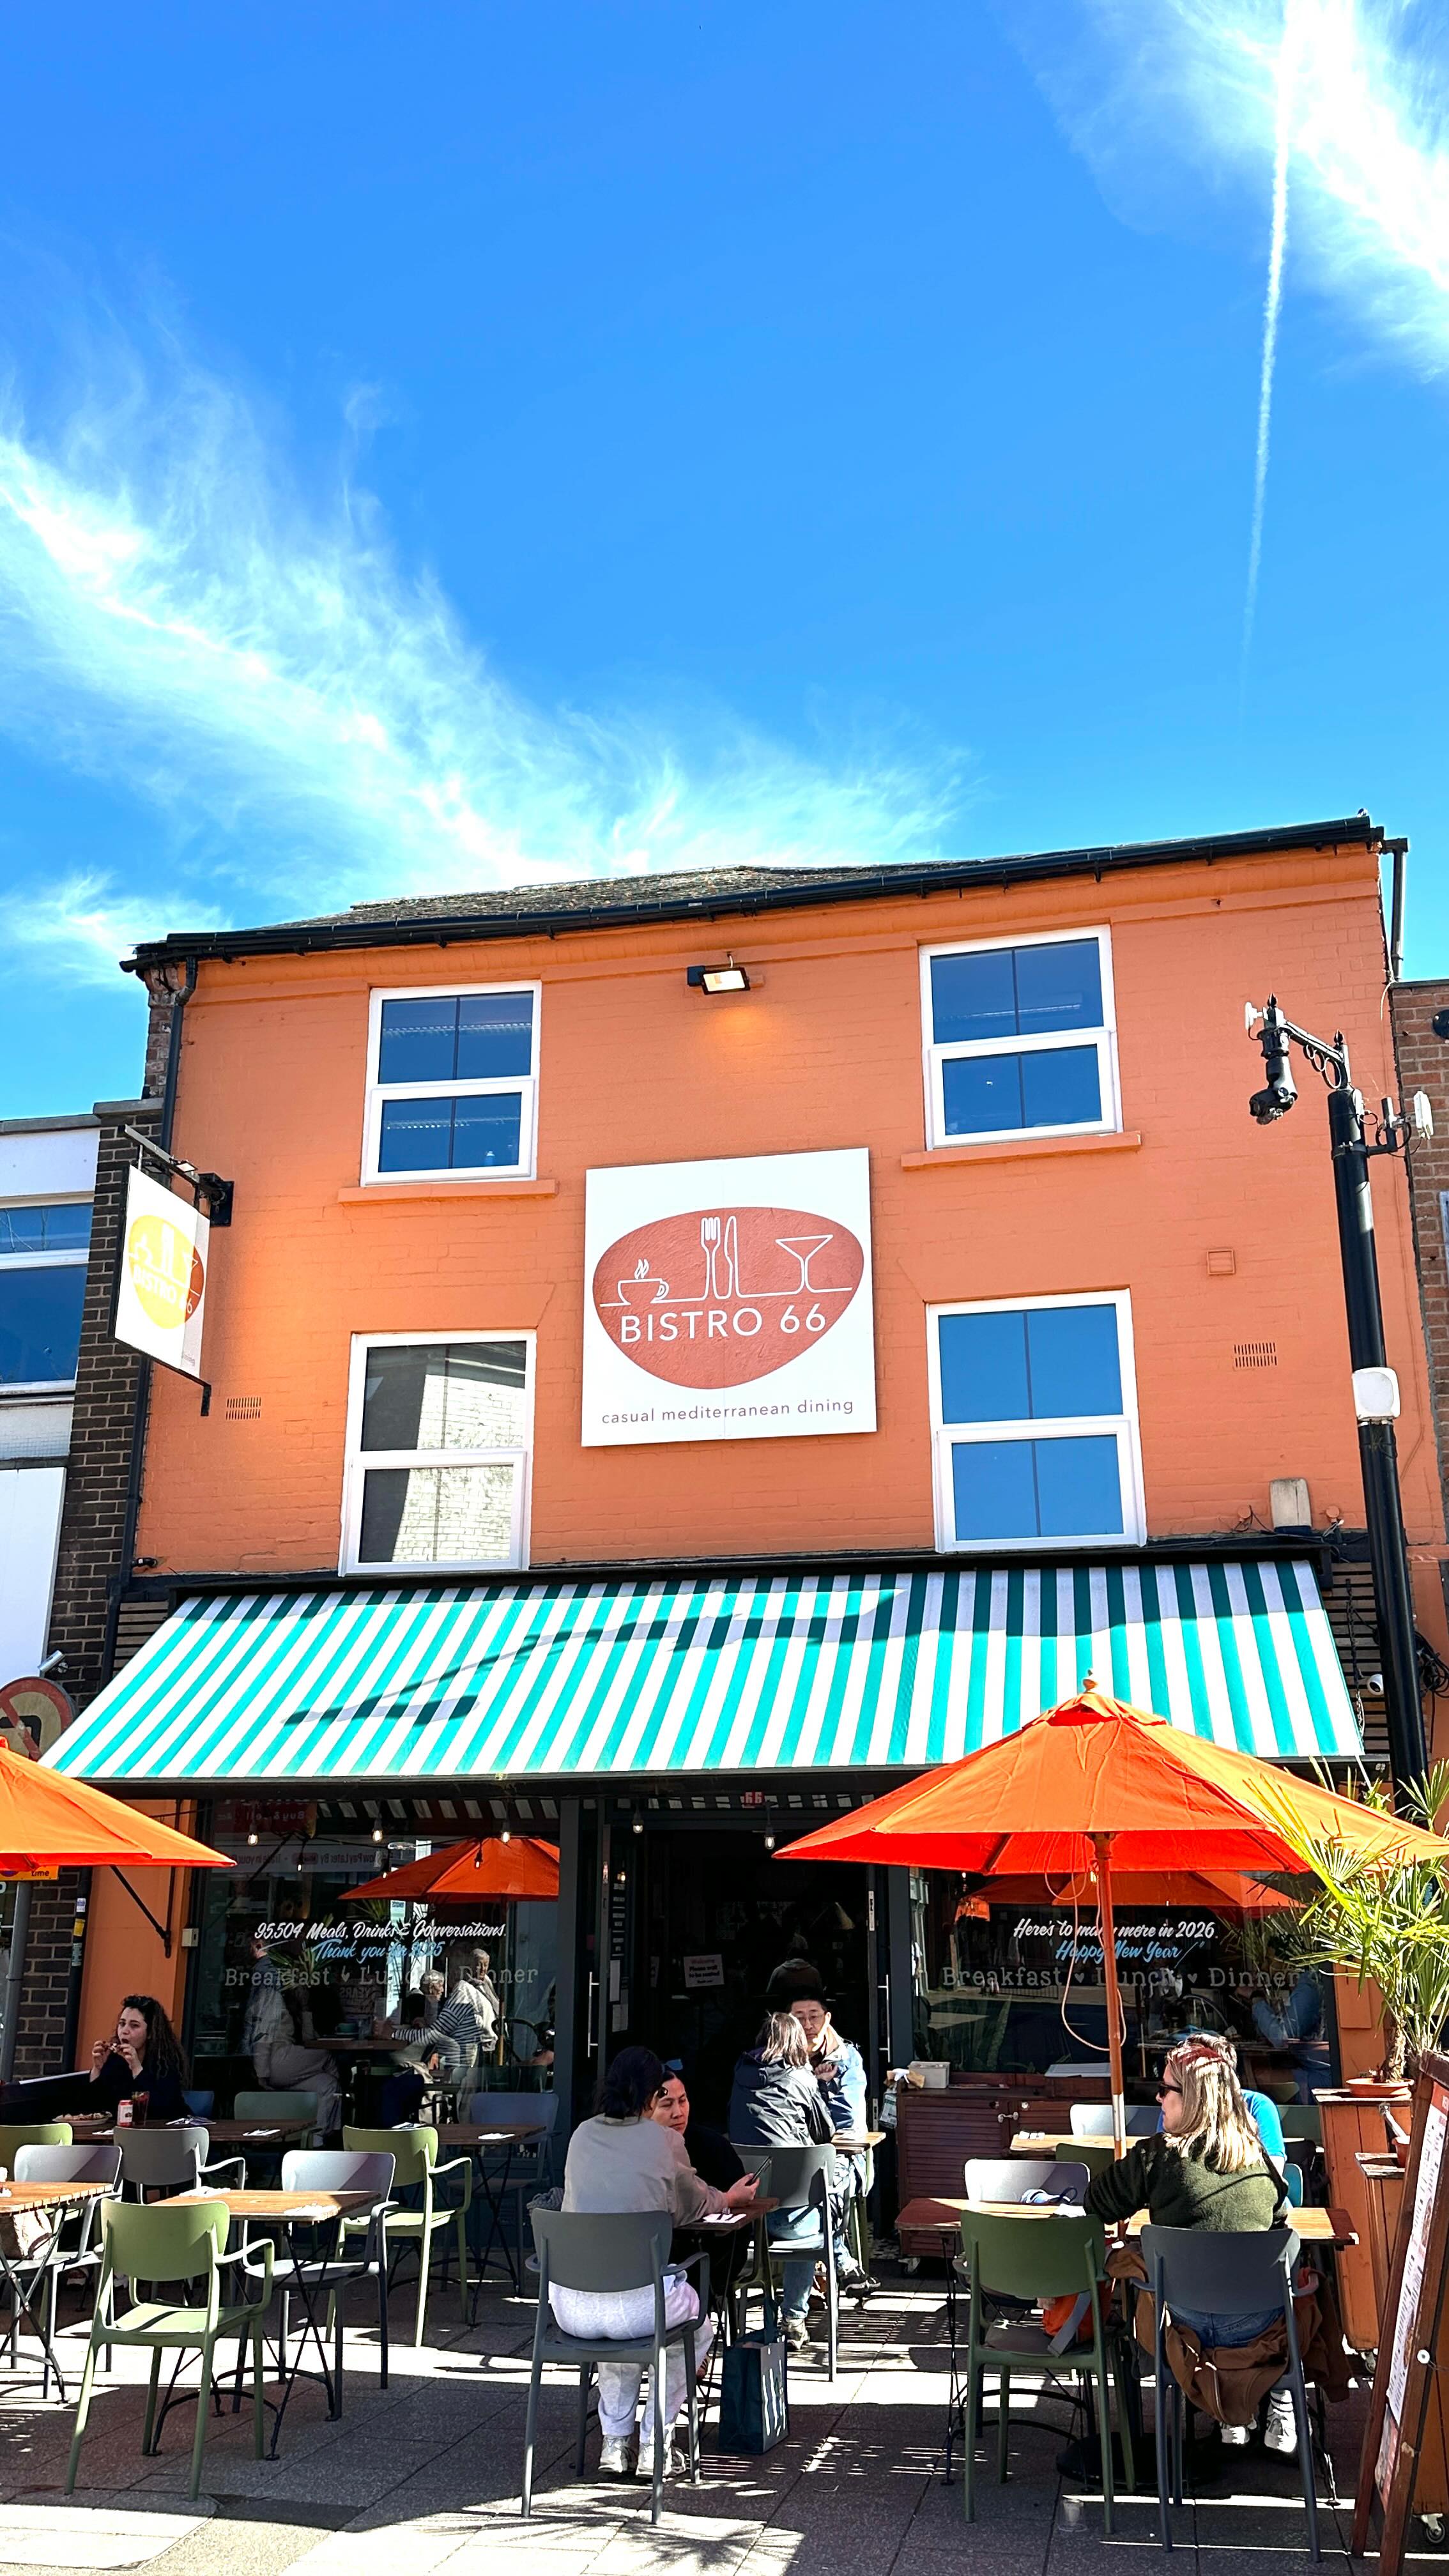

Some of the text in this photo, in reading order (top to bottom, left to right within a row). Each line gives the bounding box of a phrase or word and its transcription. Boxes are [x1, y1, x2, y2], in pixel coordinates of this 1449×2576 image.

[620, 1303, 826, 1344] BISTRO 66
[602, 1399, 854, 1424] casual mediterranean dining
[745, 1791, 762, 1804] 66
[353, 1920, 395, 1938] Drinks
[1013, 1918, 1055, 1938] Here's
[1056, 1920, 1072, 1936] to
[1118, 1924, 1156, 1938] more
[1158, 1923, 1174, 1938] in
[311, 1938, 358, 1962] Thank
[356, 1945, 385, 1964] you
[1055, 1940, 1182, 1964] Happy New Year
[224, 1968, 330, 1986] Breakfast
[942, 1966, 1062, 1986] Breakfast
